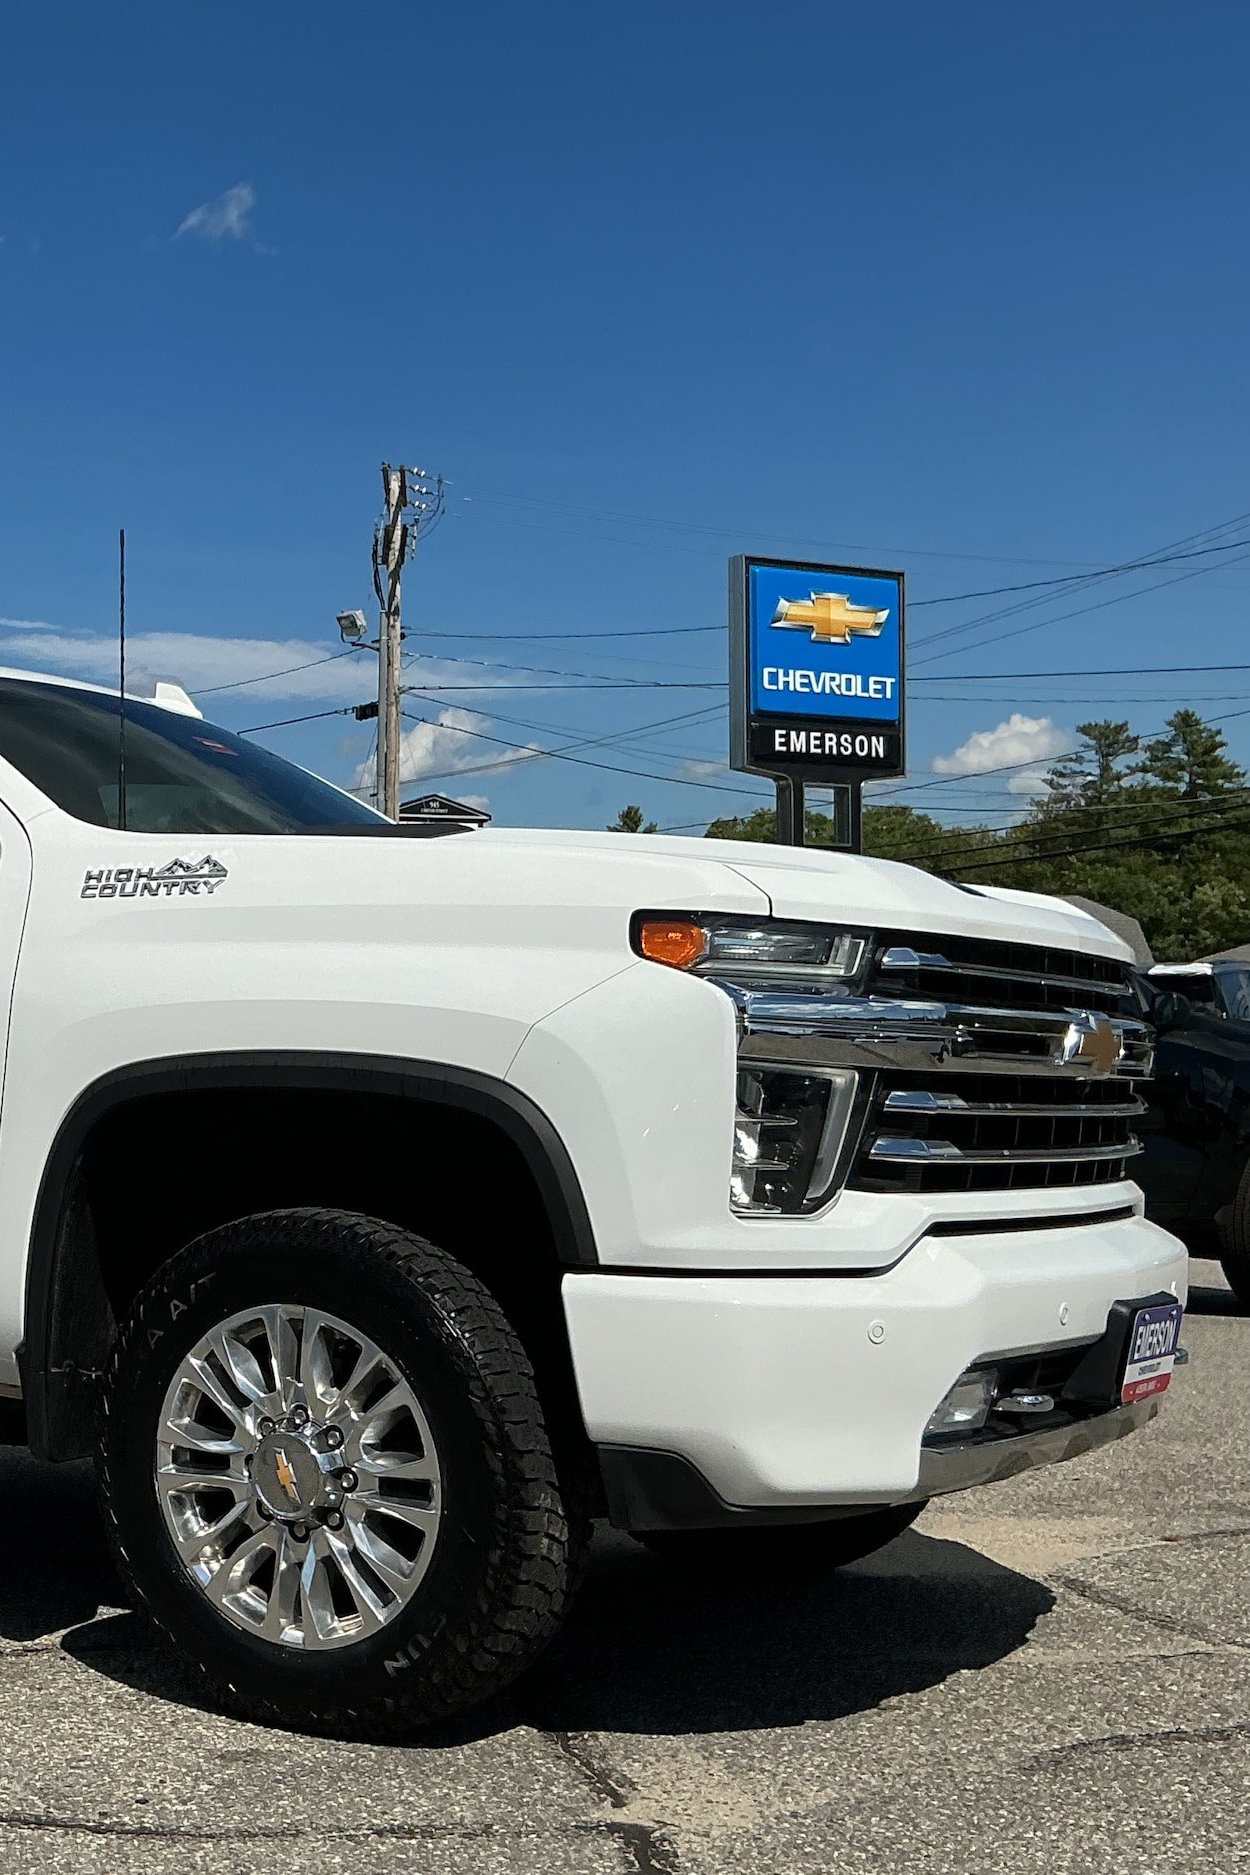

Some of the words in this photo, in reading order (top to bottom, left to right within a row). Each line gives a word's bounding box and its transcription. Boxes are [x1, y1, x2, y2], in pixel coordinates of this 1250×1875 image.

[762, 667, 896, 699] CHEVROLET
[774, 729, 885, 758] EMERSON
[80, 880, 226, 898] COUNTRY
[84, 867, 153, 884] HIGH
[1133, 1318, 1178, 1360] EMERSON
